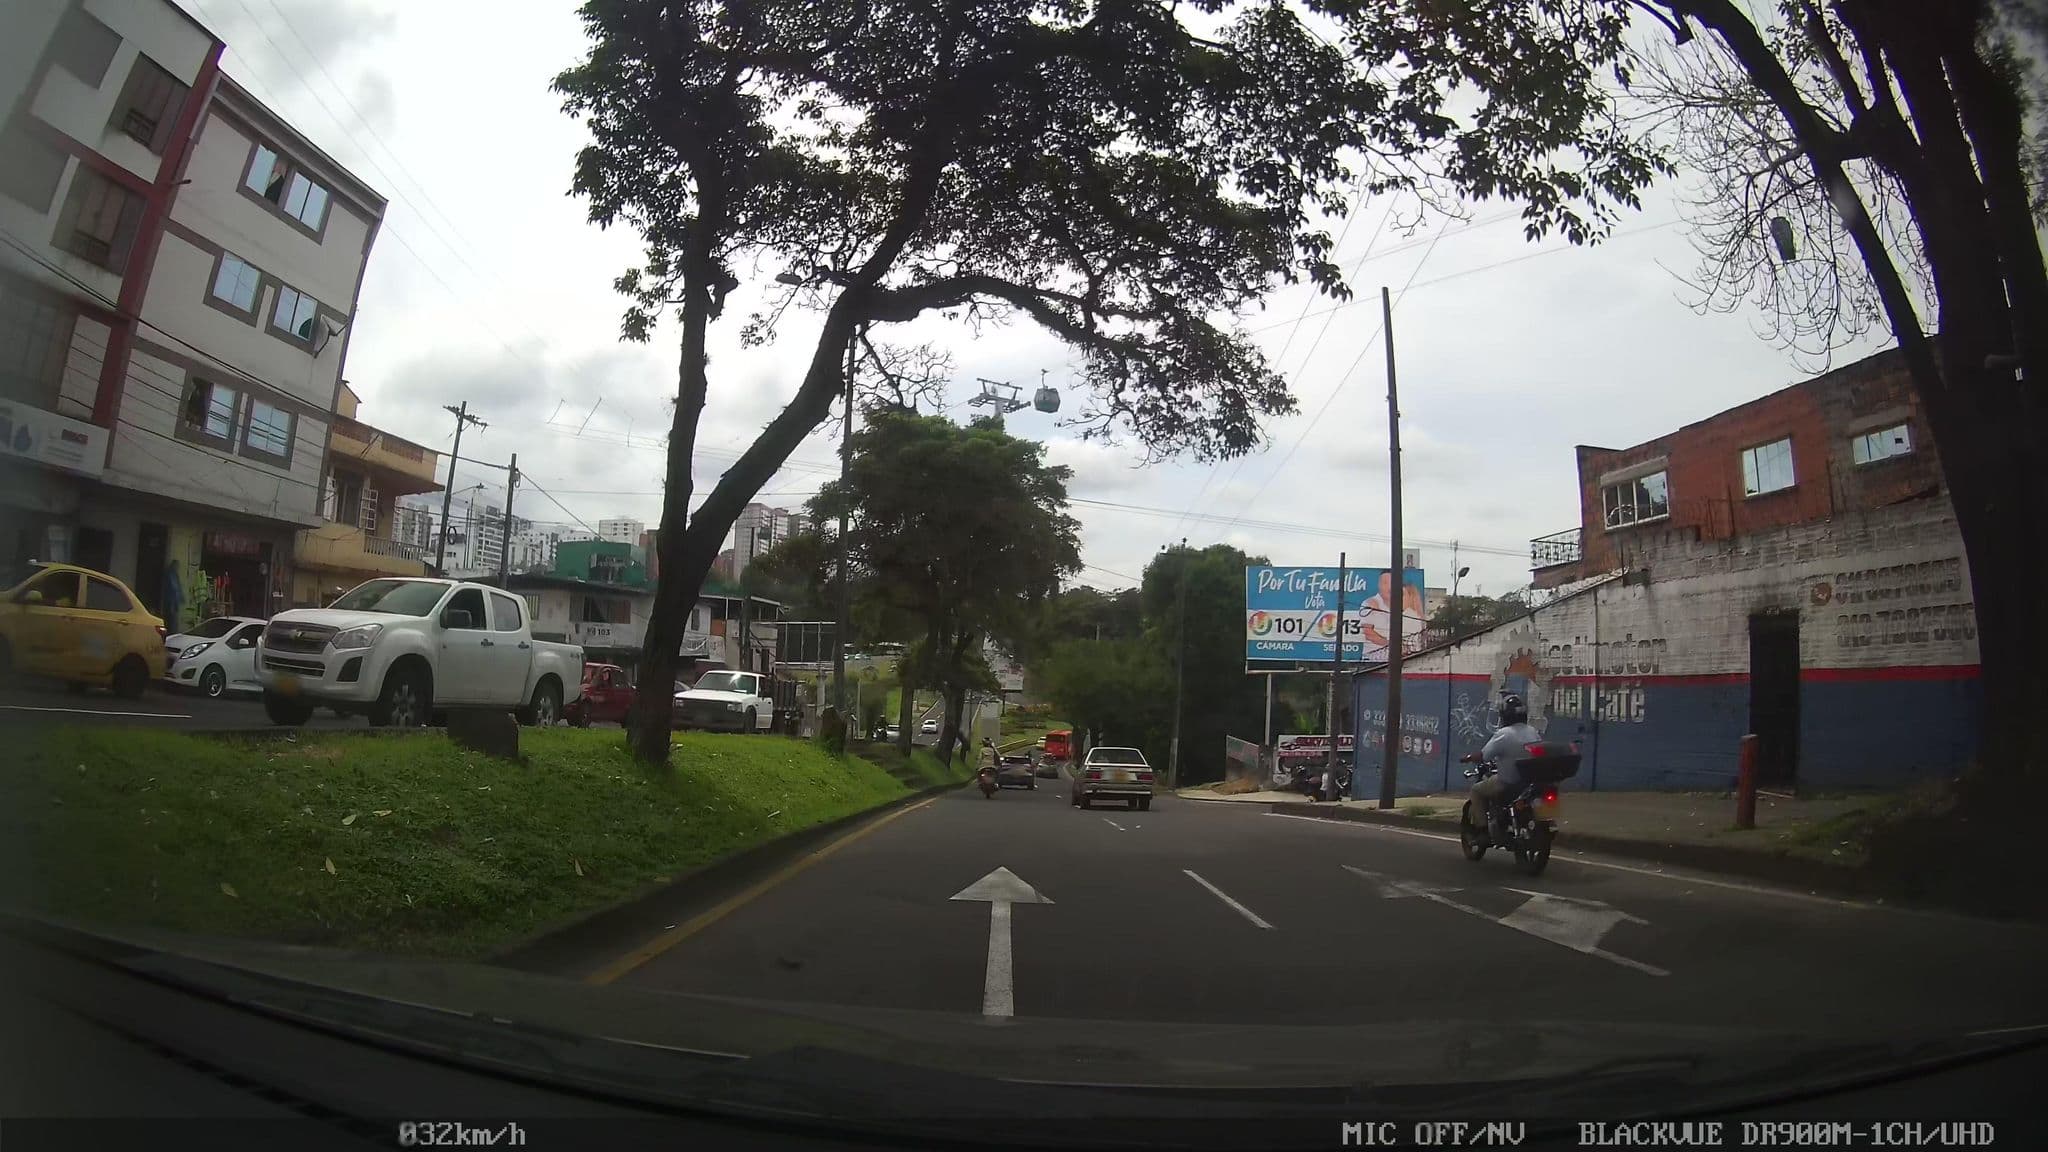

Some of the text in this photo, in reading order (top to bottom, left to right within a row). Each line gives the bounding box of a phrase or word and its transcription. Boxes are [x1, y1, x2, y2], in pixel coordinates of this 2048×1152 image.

[1258, 569, 1285, 593] Por
[1284, 569, 1306, 592] Tu
[1305, 591, 1325, 608] Vota
[1275, 618, 1303, 633] 101
[1343, 619, 1361, 634] 13
[1554, 680, 1645, 723] del Café
